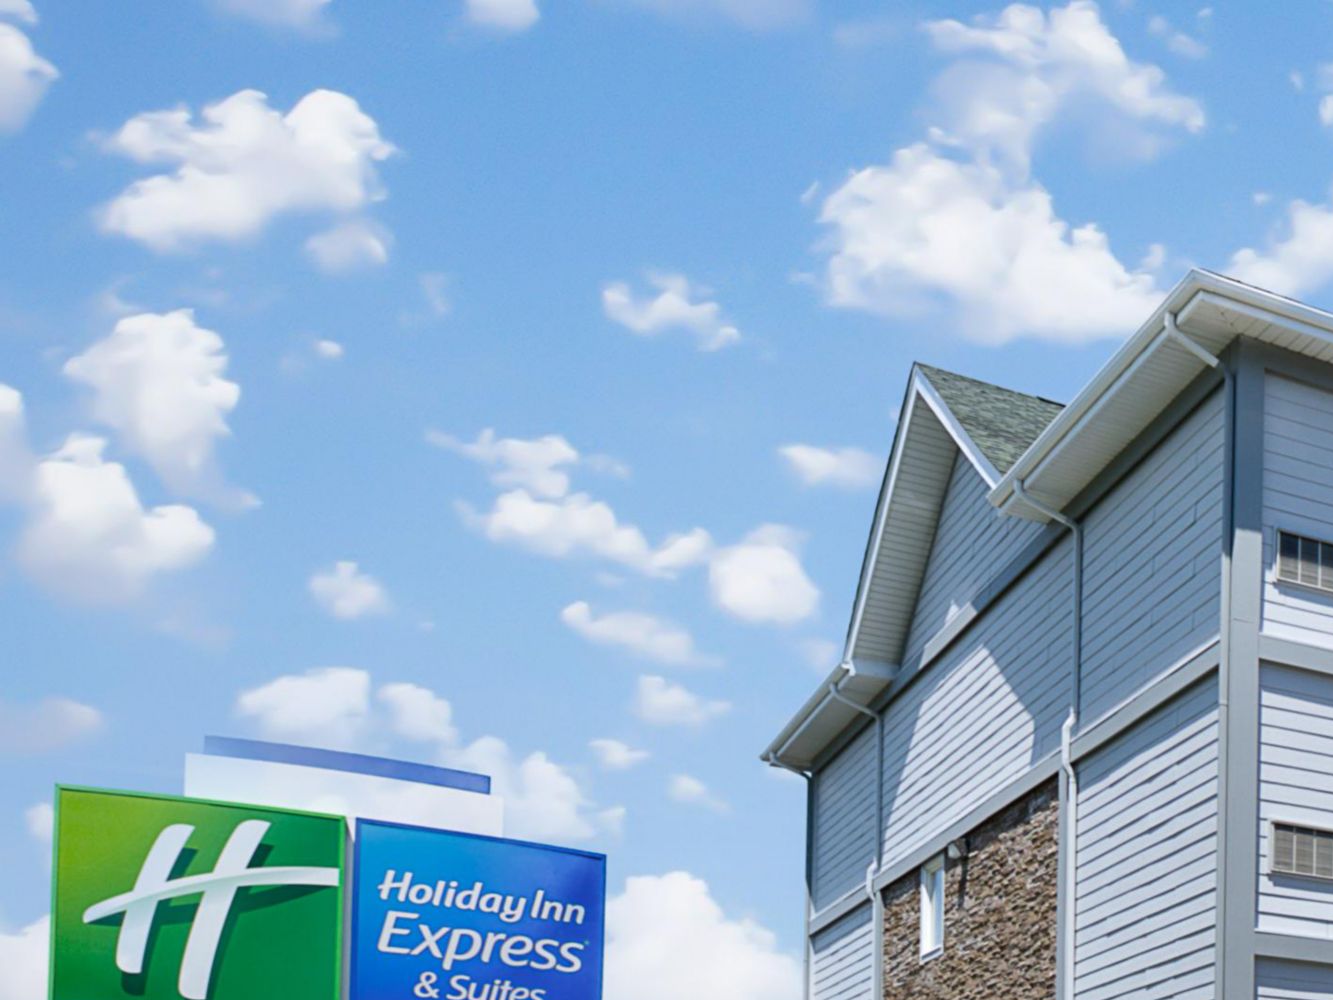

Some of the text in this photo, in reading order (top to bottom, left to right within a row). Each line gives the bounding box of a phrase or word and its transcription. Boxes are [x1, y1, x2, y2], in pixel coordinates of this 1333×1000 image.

[82, 819, 340, 1000] H
[377, 869, 585, 925] Holiday Inn
[377, 910, 585, 973] Express
[413, 971, 439, 998] &
